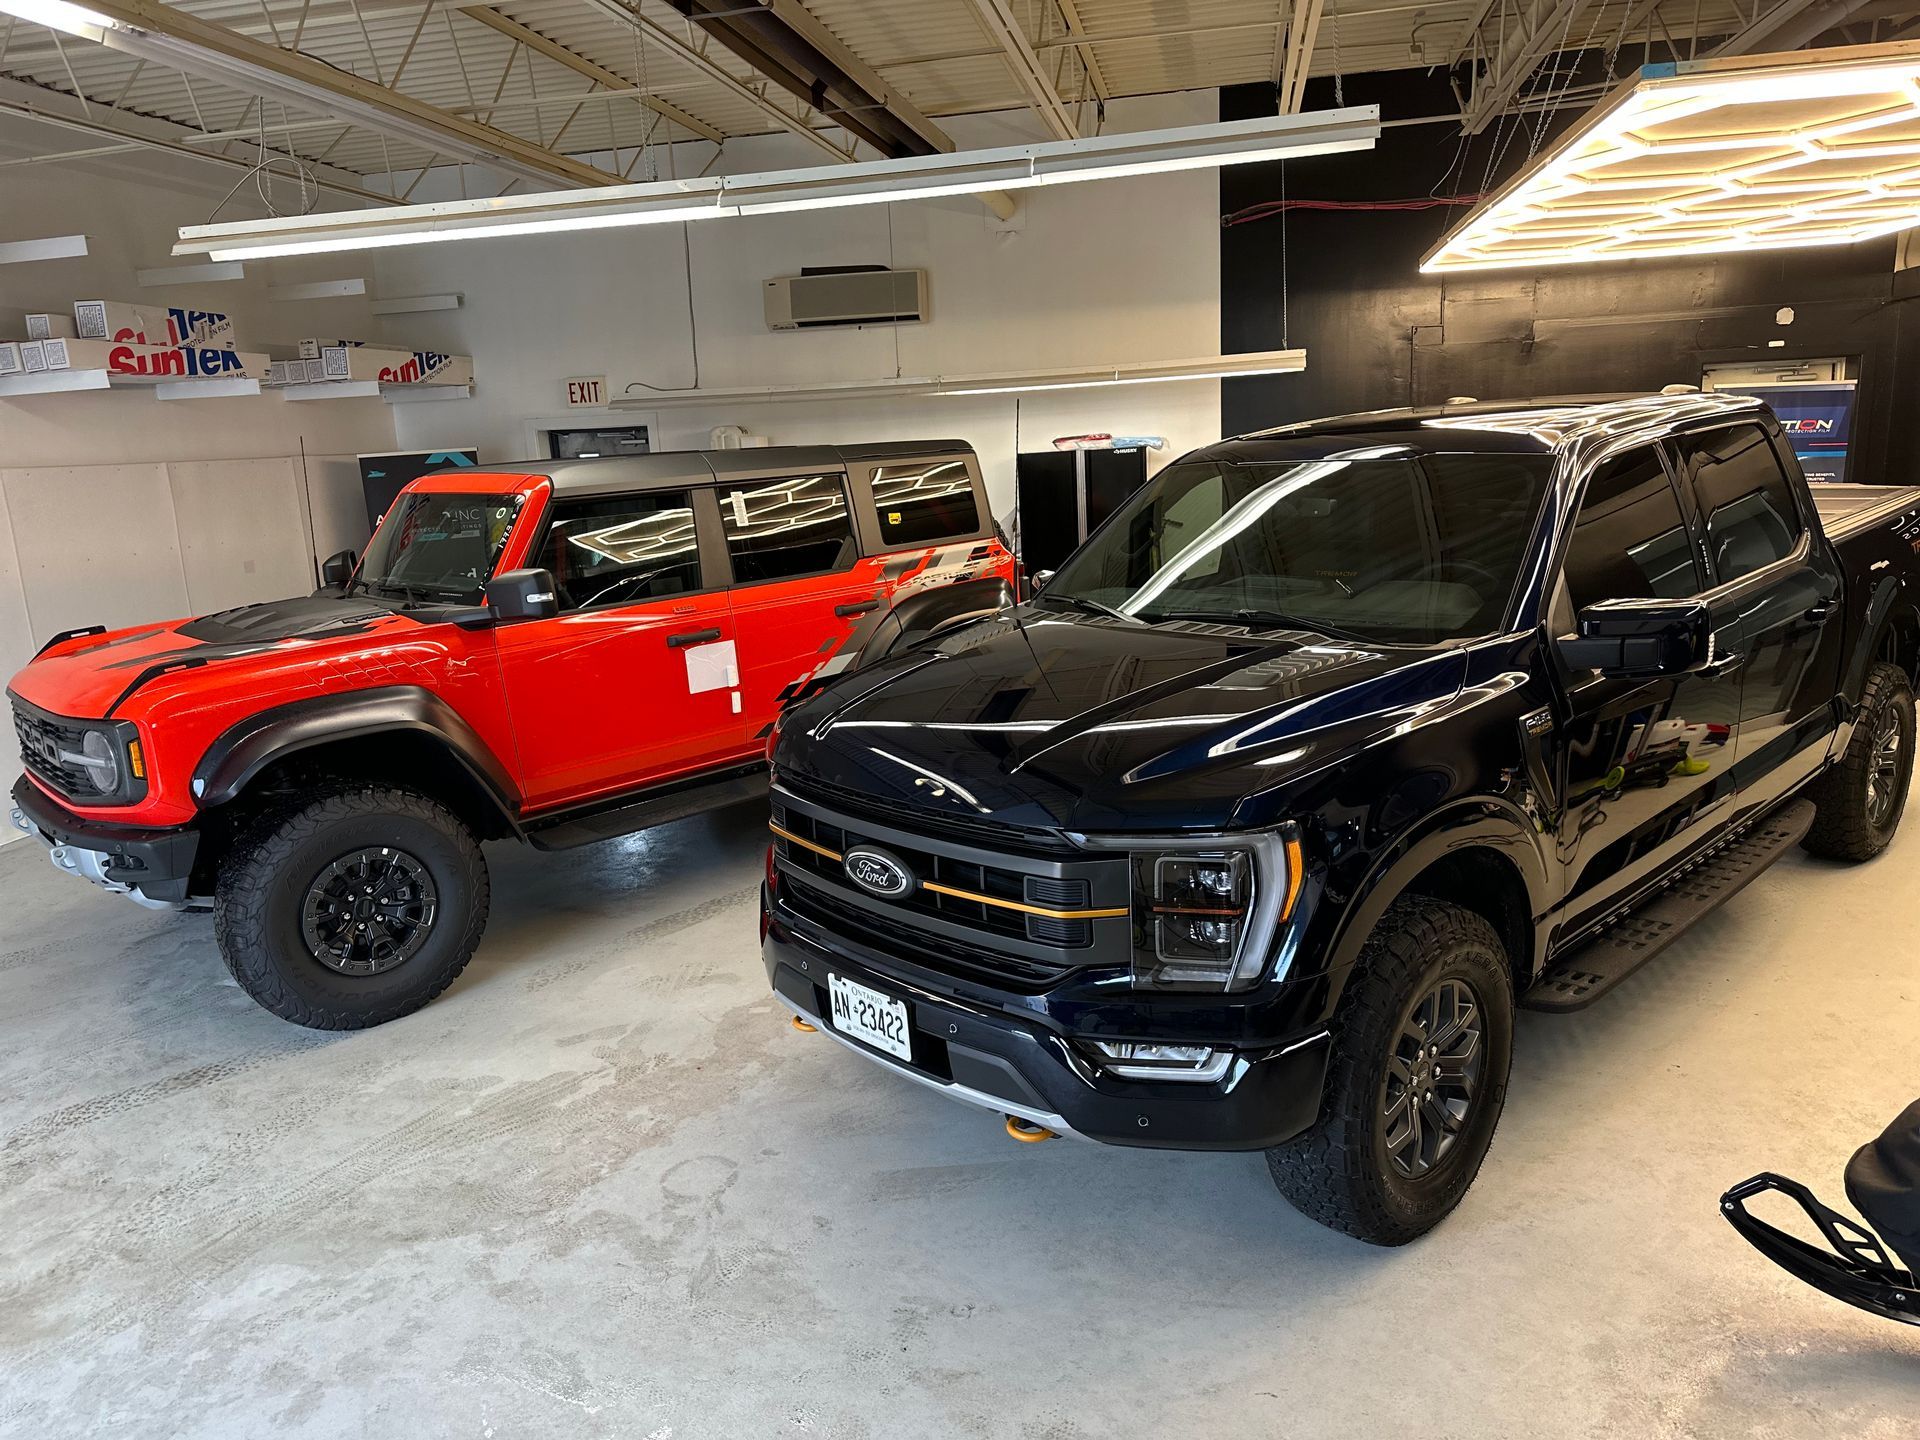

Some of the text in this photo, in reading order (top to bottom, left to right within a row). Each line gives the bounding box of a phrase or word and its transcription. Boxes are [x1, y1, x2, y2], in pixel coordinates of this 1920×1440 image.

[569, 382, 598, 403] EXIT
[857, 860, 888, 886] Ford
[852, 986, 882, 1005] ONTARIO
[835, 989, 906, 1046] AN 23422
